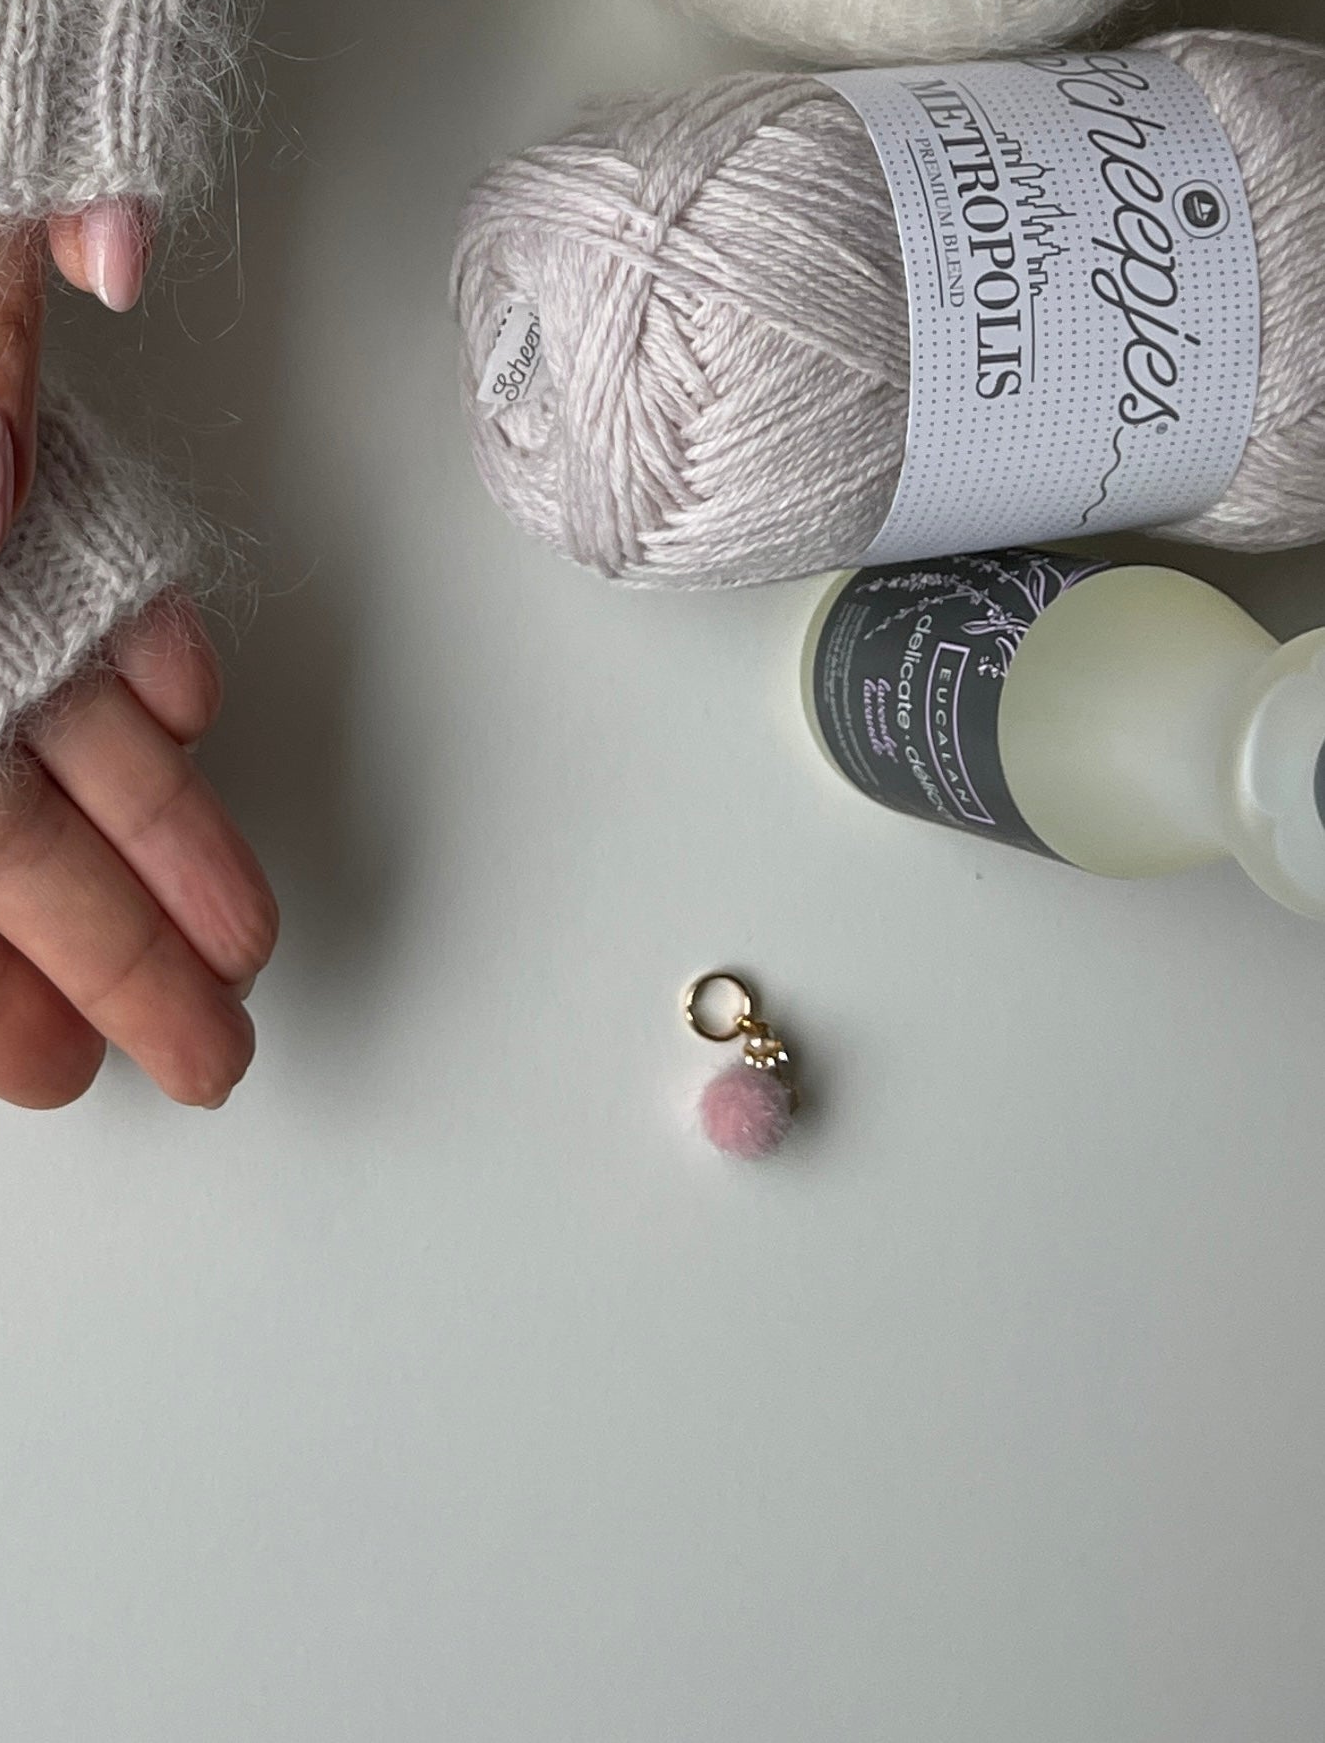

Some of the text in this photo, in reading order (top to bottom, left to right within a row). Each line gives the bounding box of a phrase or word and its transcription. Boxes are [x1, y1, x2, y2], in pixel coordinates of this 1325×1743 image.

[899, 78, 1023, 400] METROPOLIS
[914, 137, 965, 308] PREMIUM BLEND
[1018, 55, 1201, 426] Scheepjes
[896, 614, 933, 730] delicate
[935, 667, 971, 803] EUCALAN
